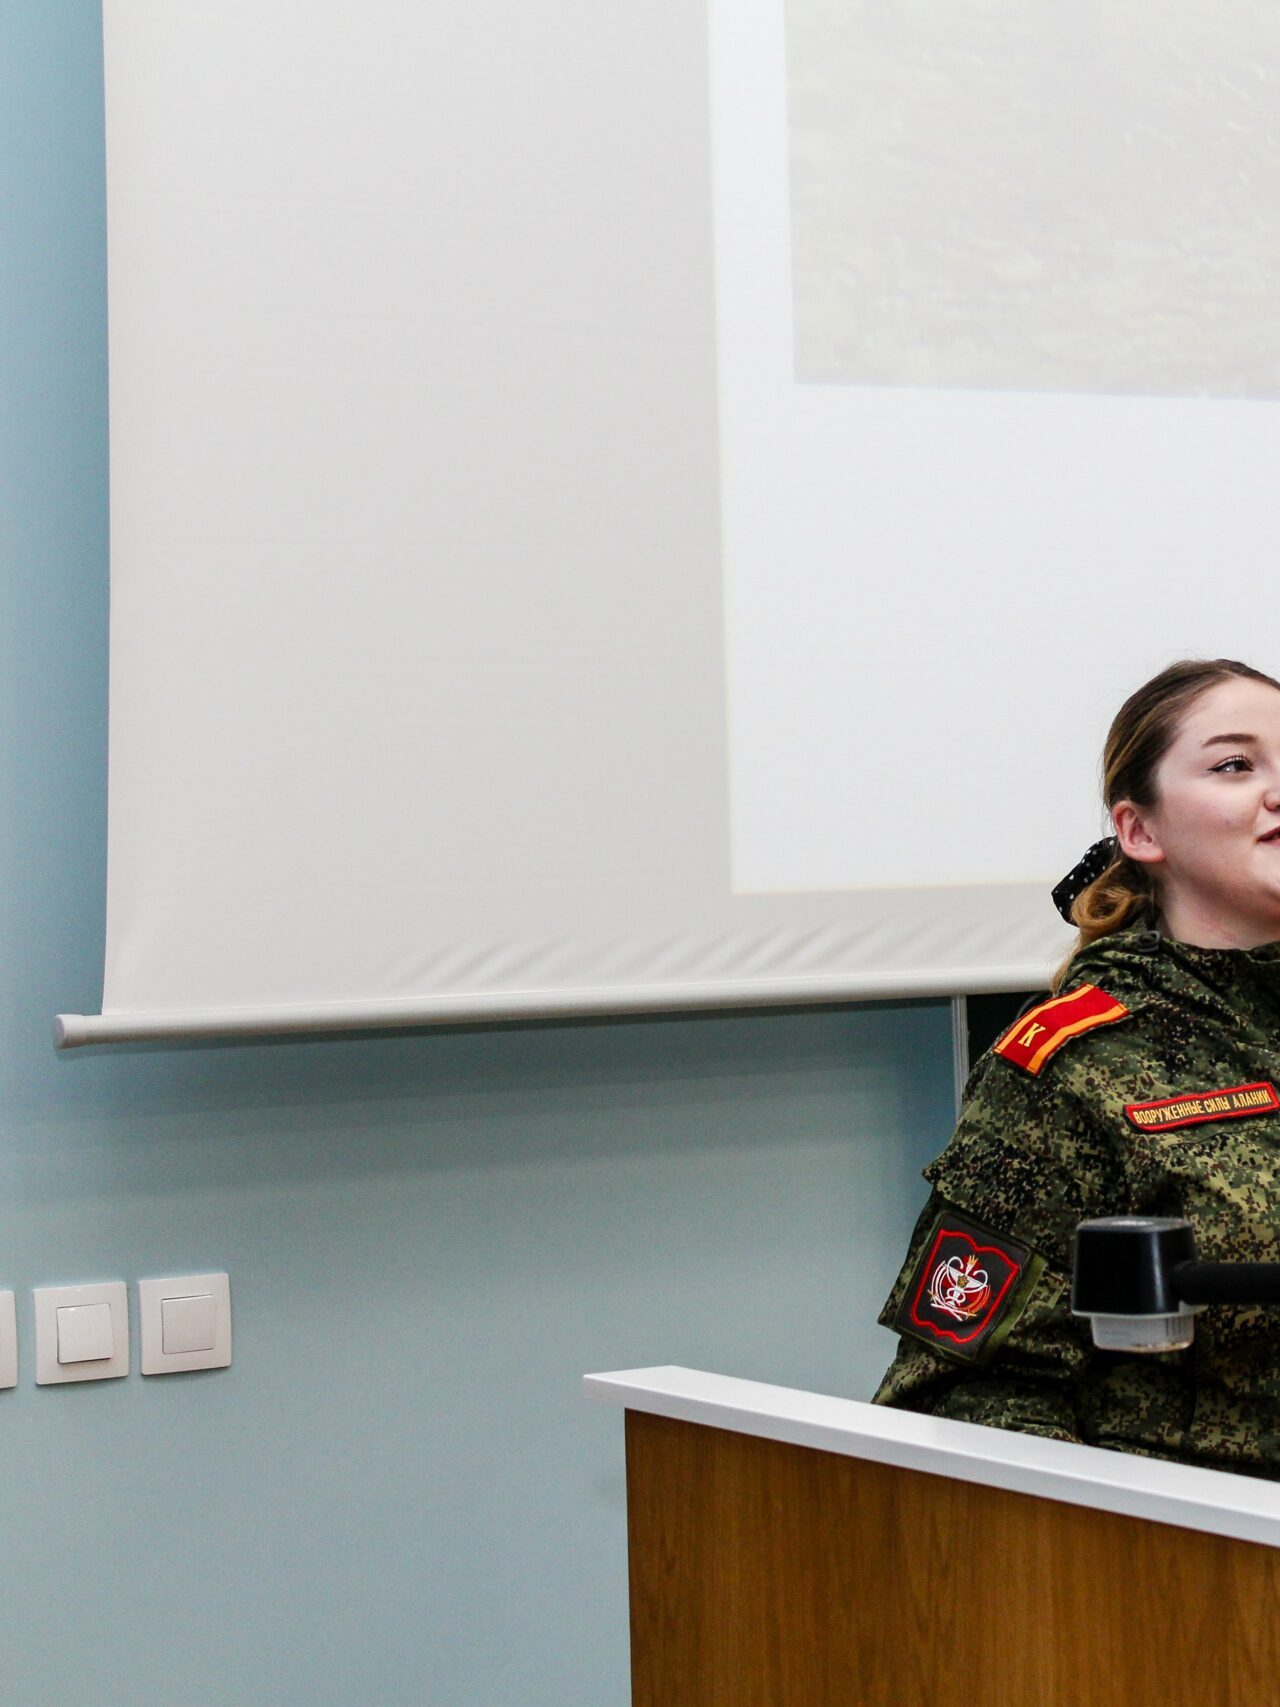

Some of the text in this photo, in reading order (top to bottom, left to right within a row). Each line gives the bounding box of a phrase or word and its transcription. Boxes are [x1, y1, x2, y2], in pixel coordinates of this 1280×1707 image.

[1019, 1023, 1046, 1047] К
[1132, 1089, 1272, 1125] ВООРУЖЕННЫЕ СИЛЫ АЛАНИИ
